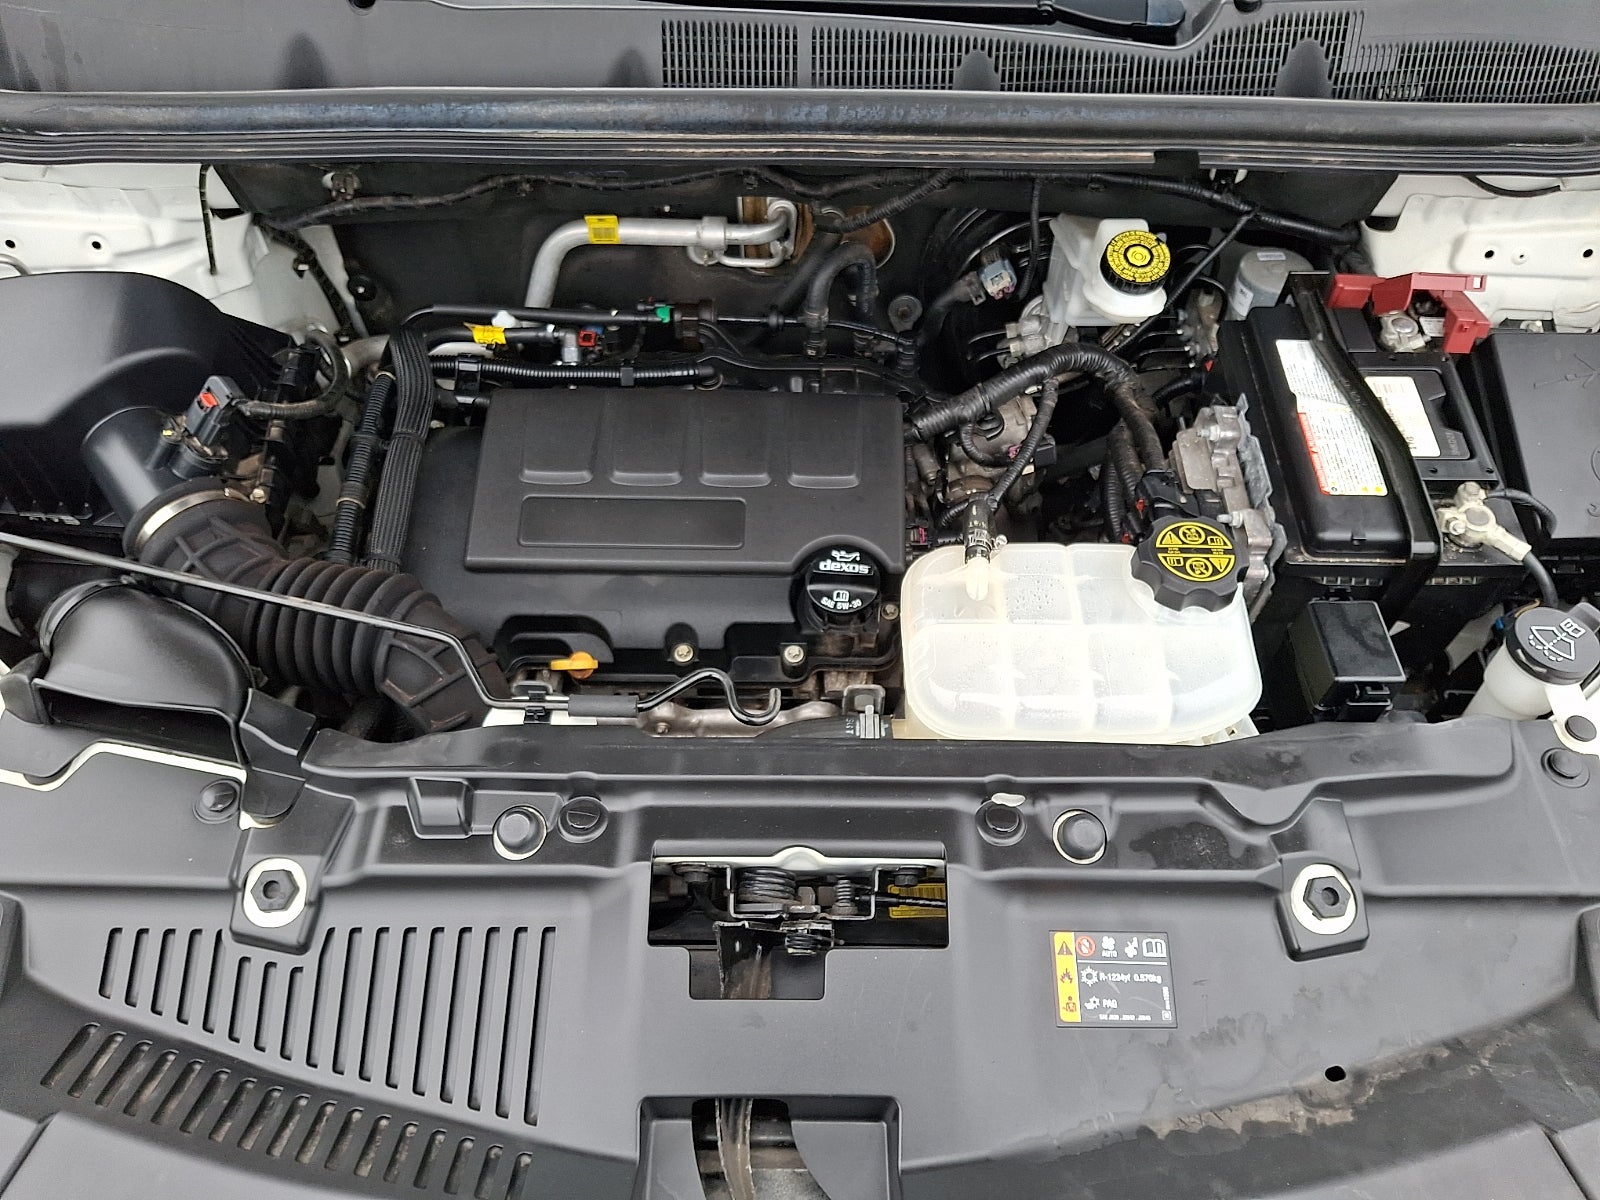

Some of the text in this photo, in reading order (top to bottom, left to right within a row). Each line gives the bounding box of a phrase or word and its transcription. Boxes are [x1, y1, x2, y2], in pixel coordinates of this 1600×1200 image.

[819, 559, 870, 574] dexos
[820, 597, 862, 610] SAE 5W-30
[1101, 950, 1118, 958] AUTO
